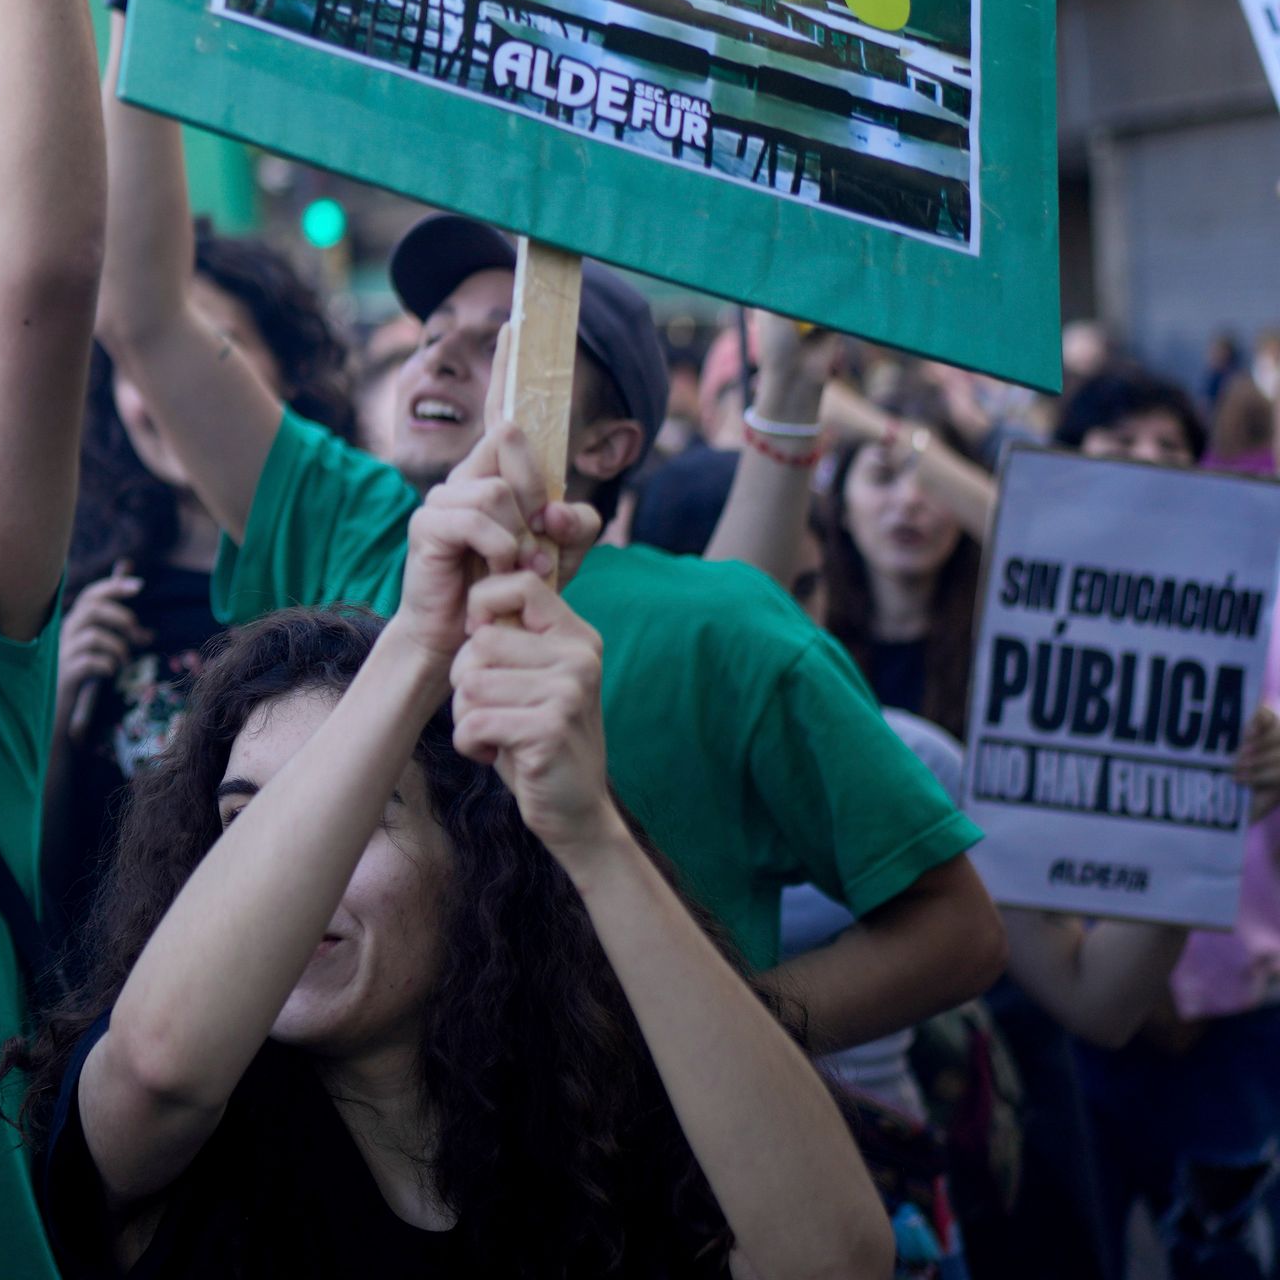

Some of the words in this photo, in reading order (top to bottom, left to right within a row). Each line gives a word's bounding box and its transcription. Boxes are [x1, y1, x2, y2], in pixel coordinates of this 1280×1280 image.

[493, 39, 630, 124] ALDE
[633, 82, 667, 105] SEC.
[669, 93, 711, 119] GRAL
[630, 97, 708, 149] FUR
[1000, 557, 1063, 612] SIN
[1068, 565, 1265, 642] EDUCACIÓN
[986, 620, 1247, 756] PÚBLICA
[1036, 749, 1102, 810] HAY
[1108, 760, 1239, 832] FUTURO
